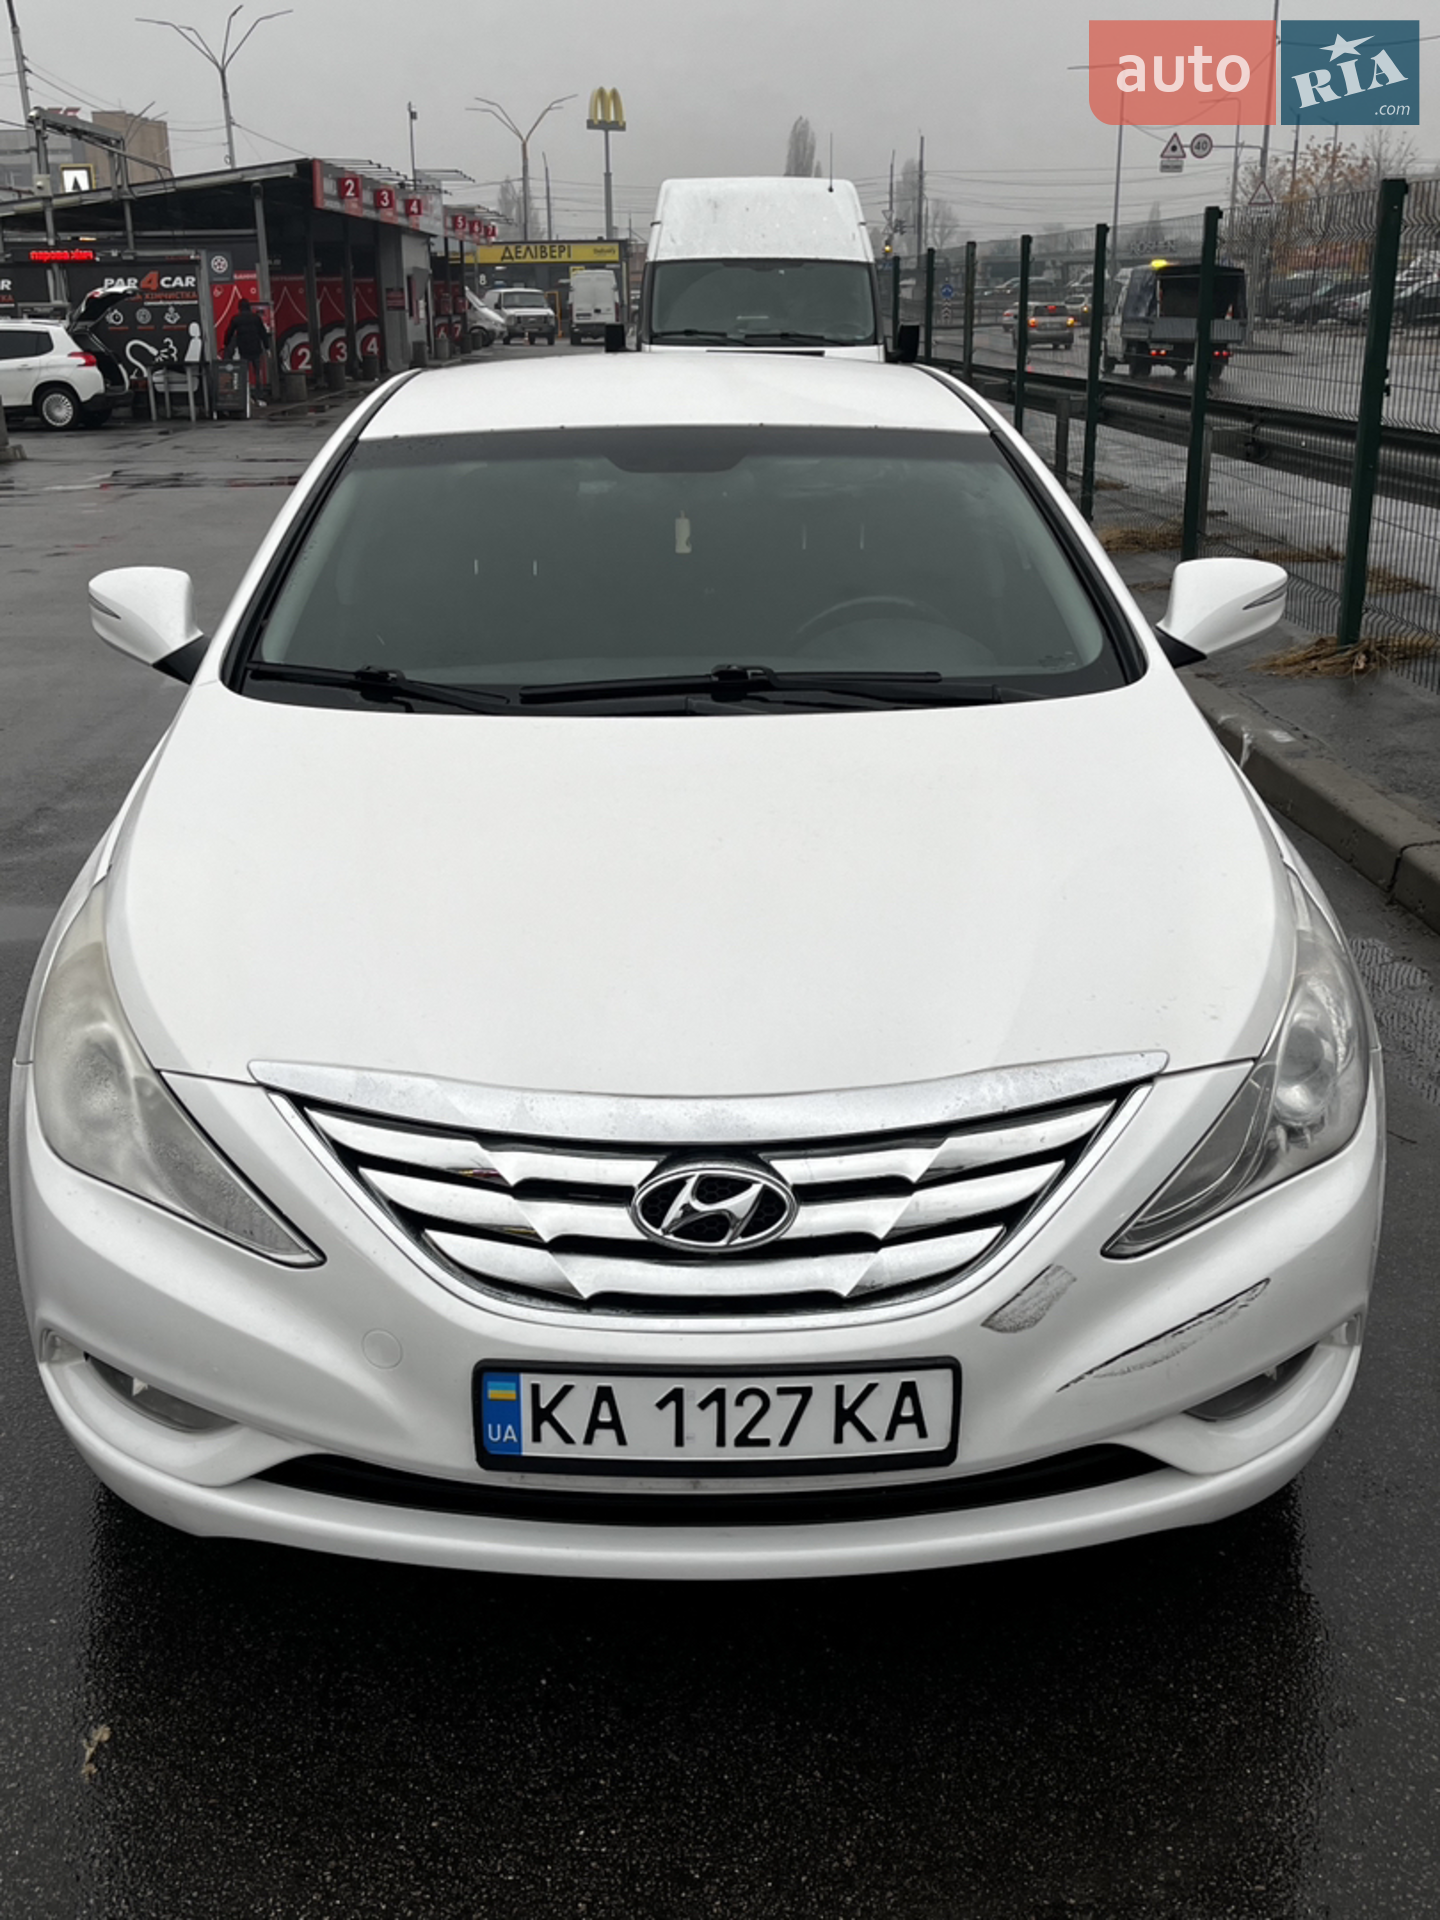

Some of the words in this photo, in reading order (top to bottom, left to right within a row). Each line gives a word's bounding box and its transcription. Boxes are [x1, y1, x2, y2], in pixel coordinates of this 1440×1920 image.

[1194, 140, 1208, 151] 40
[345, 179, 355, 197] 2
[380, 191, 390, 207] 3
[409, 200, 419, 214] 4
[457, 216, 464, 228] 5
[501, 245, 571, 261] ДЕЛІВЕРІ
[479, 273, 487, 286] 8
[454, 325, 461, 337] 7
[335, 343, 347, 362] 3
[366, 337, 379, 355] 4
[297, 347, 312, 370] 2
[487, 1423, 518, 1444] UA
[529, 1382, 628, 1447] KA
[654, 1385, 814, 1448] 1127
[833, 1380, 929, 1445] KA
